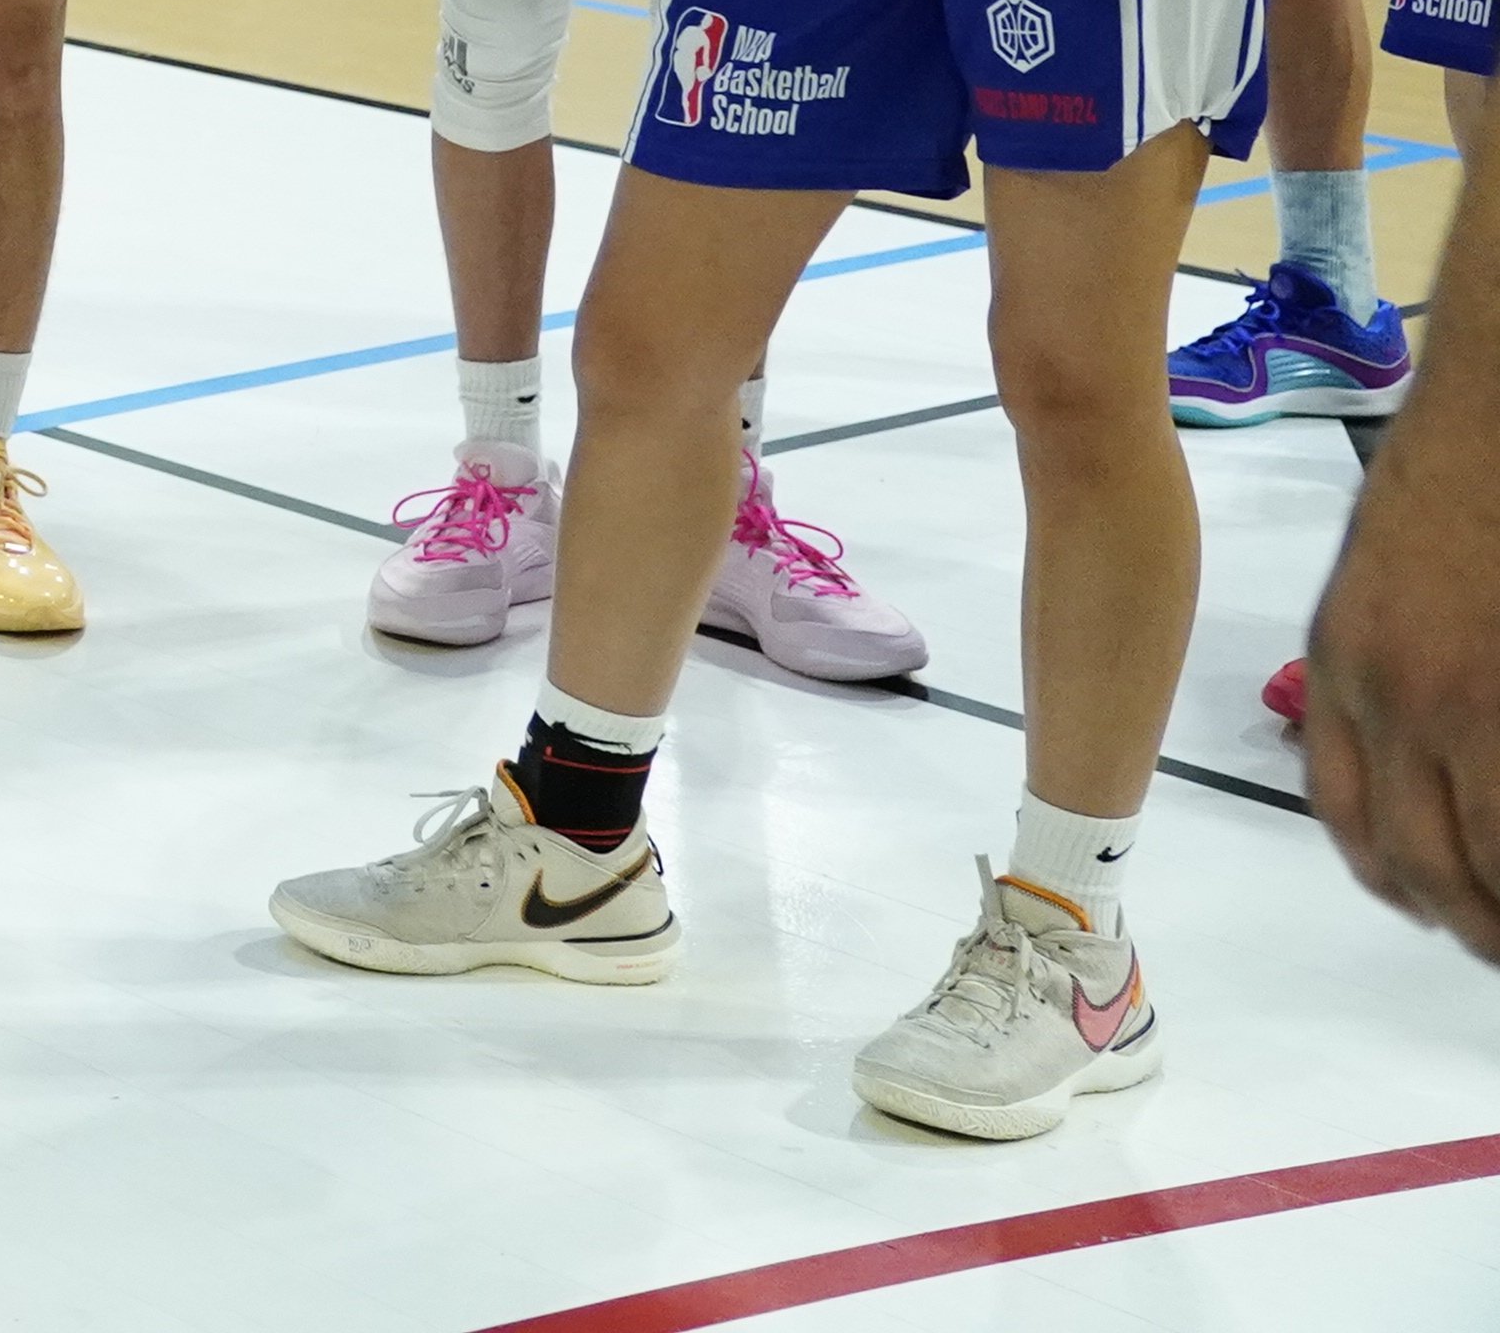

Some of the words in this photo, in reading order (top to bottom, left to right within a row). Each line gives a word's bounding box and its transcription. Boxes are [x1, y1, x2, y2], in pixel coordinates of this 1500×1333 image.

[731, 24, 777, 64] NBA
[713, 63, 850, 103] Basketball
[710, 94, 799, 135] School
